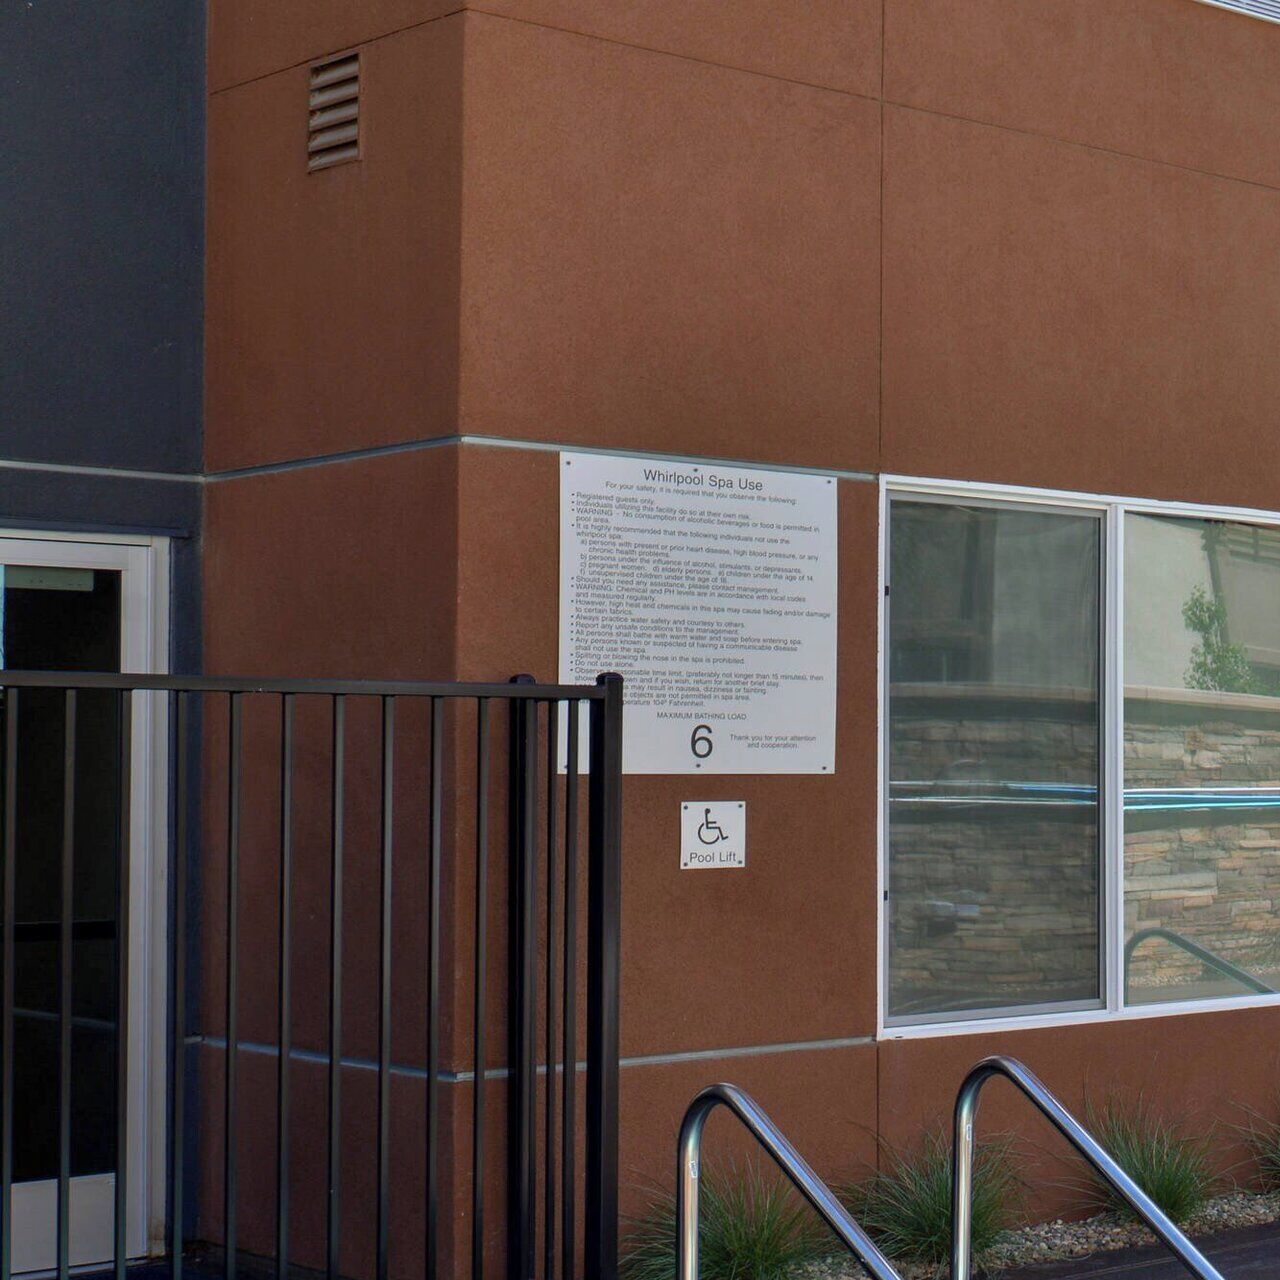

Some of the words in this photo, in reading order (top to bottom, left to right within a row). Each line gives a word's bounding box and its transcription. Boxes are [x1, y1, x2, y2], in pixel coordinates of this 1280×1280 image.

[643, 468, 703, 486] Whirlpool
[708, 474, 734, 489] Spa
[738, 477, 763, 491] Use
[694, 711, 725, 719] BATHING
[691, 724, 713, 758] 6
[690, 851, 715, 863] Pool
[719, 850, 736, 862] Lift
